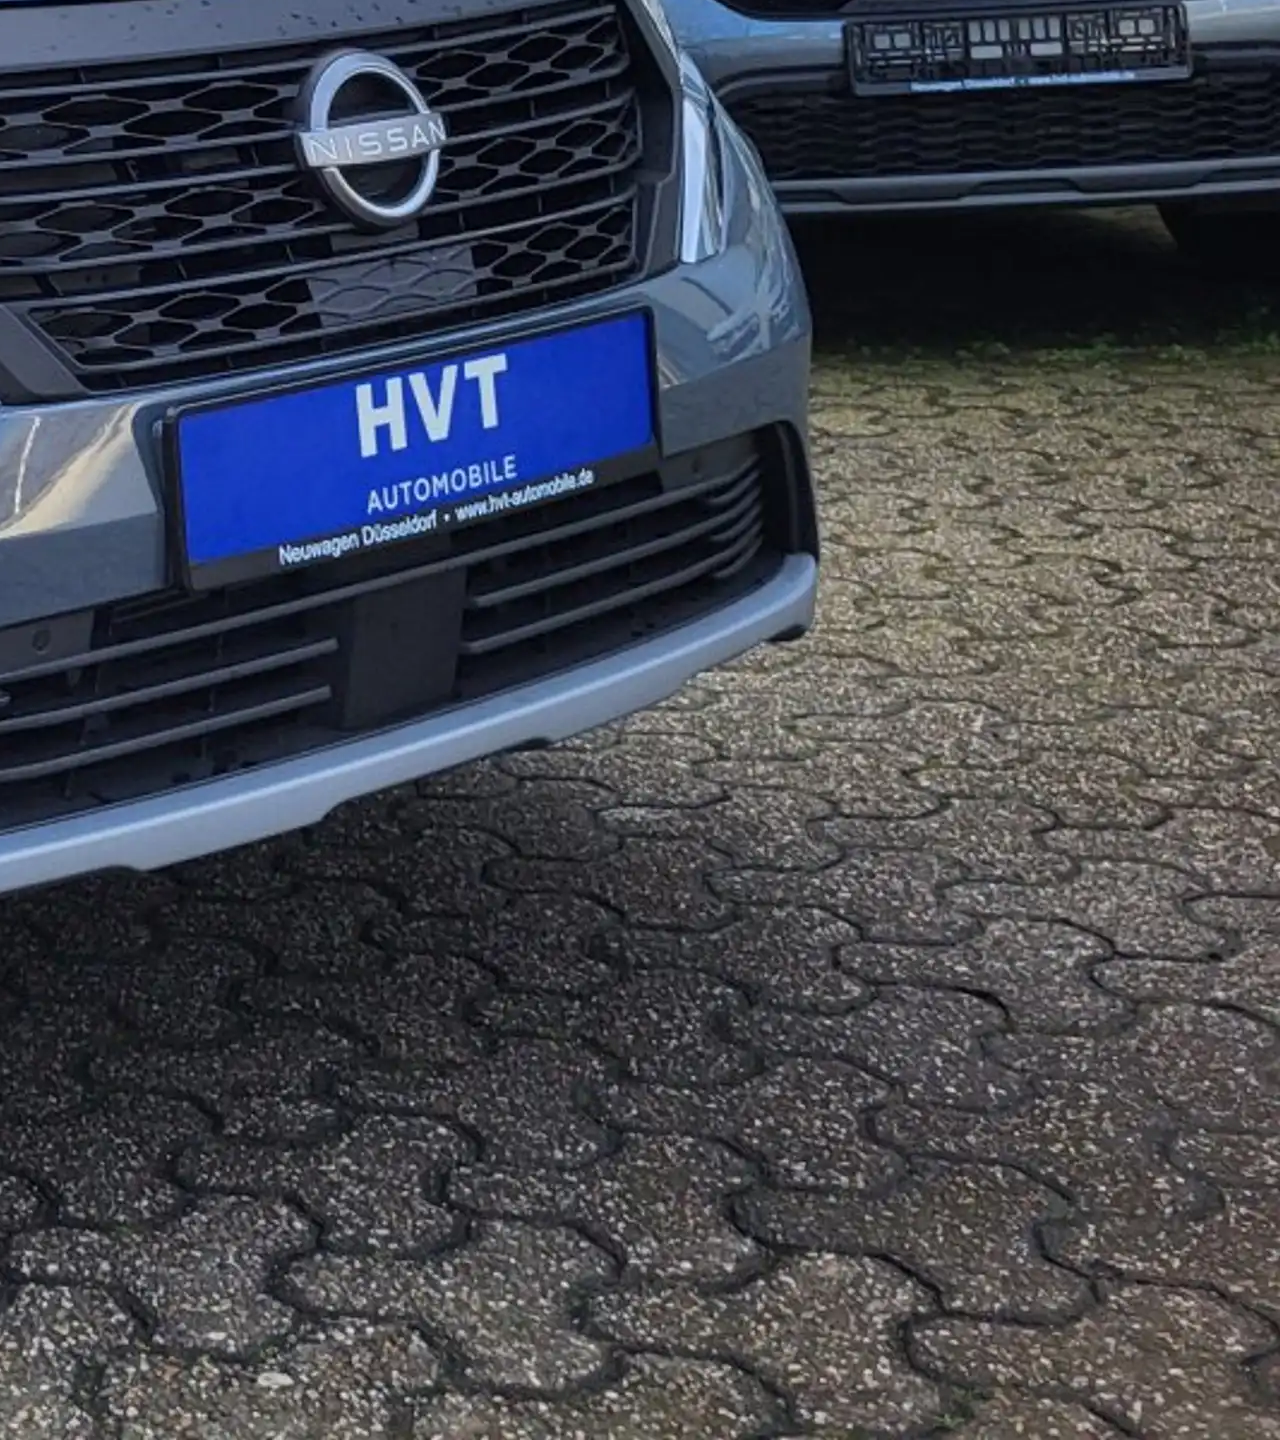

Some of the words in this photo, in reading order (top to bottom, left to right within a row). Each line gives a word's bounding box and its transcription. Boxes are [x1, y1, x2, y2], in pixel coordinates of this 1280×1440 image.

[308, 119, 448, 164] NISSAN
[355, 353, 509, 458] HVT
[367, 454, 518, 515] AUTOMOBILE
[278, 533, 361, 565] Neuwagen
[362, 509, 438, 547] Düsseldorf
